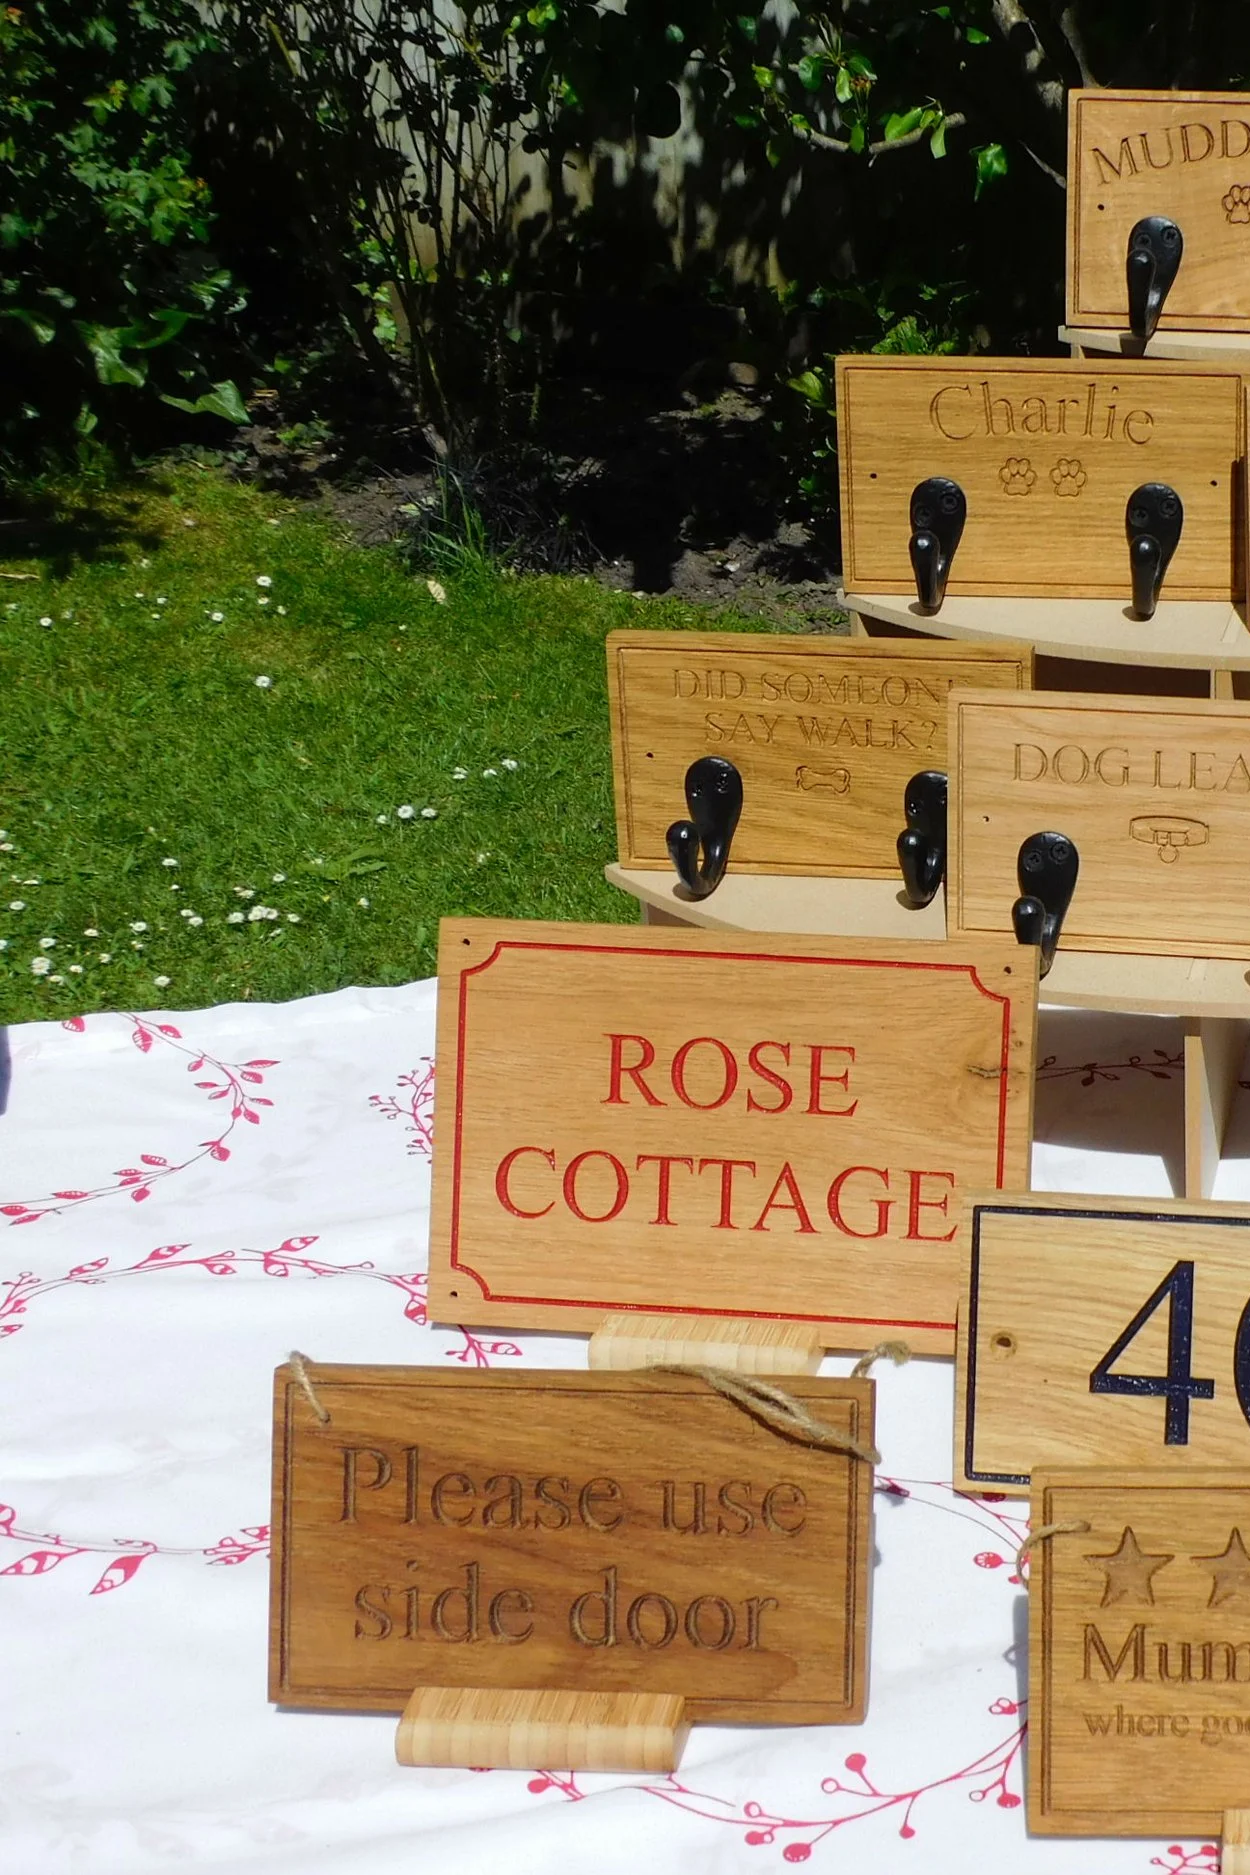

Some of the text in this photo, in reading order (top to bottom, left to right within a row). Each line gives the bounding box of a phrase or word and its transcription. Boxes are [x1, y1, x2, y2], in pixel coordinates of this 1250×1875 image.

[929, 381, 1154, 445] Charlie
[671, 669, 969, 708] DID SOMEON
[704, 712, 938, 750] SAY WALK?
[1013, 743, 1130, 788] DOG
[601, 1033, 859, 1117] ROSE
[495, 1146, 958, 1242] COTTAGE
[334, 1445, 807, 1538] Please use
[353, 1559, 779, 1651] side door
[1082, 1704, 1191, 1738] where
